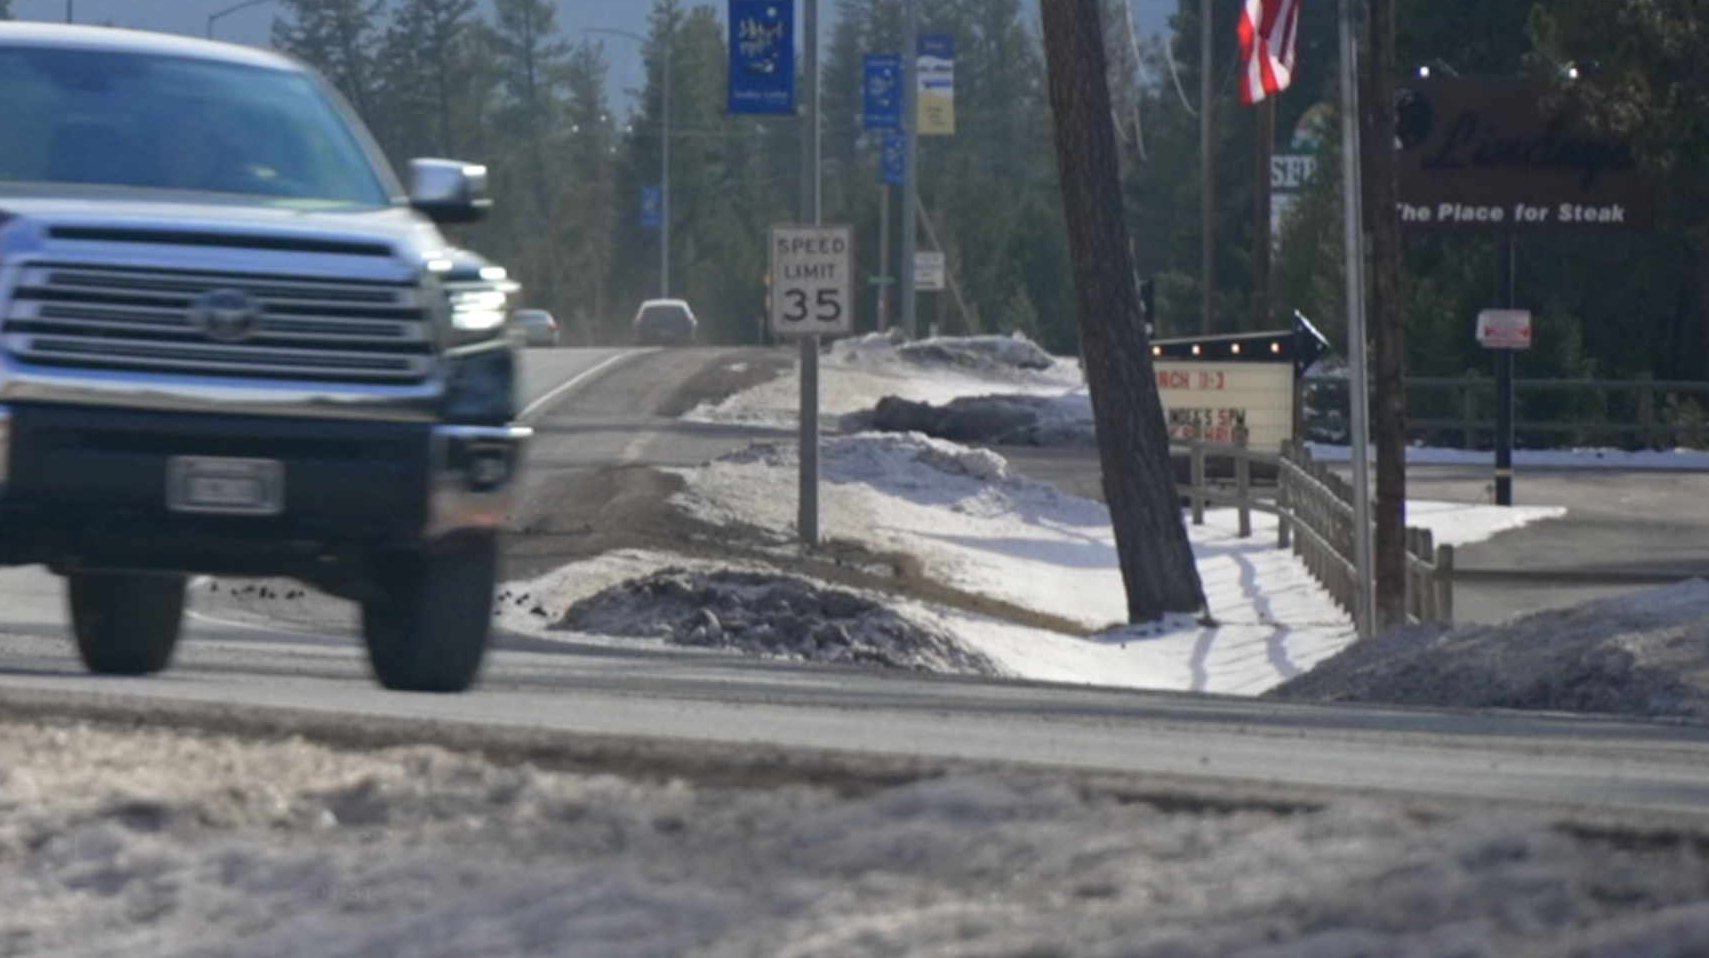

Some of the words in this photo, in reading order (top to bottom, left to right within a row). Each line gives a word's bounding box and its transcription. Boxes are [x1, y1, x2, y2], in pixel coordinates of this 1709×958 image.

[1396, 203, 1431, 222] he
[1437, 203, 1505, 222] Place
[1514, 203, 1549, 222] for
[1558, 202, 1625, 222] Steak
[777, 238, 846, 254] SPEED
[784, 263, 837, 280] LIMIT
[782, 288, 842, 323] 35
[1160, 372, 1190, 389] NCH
